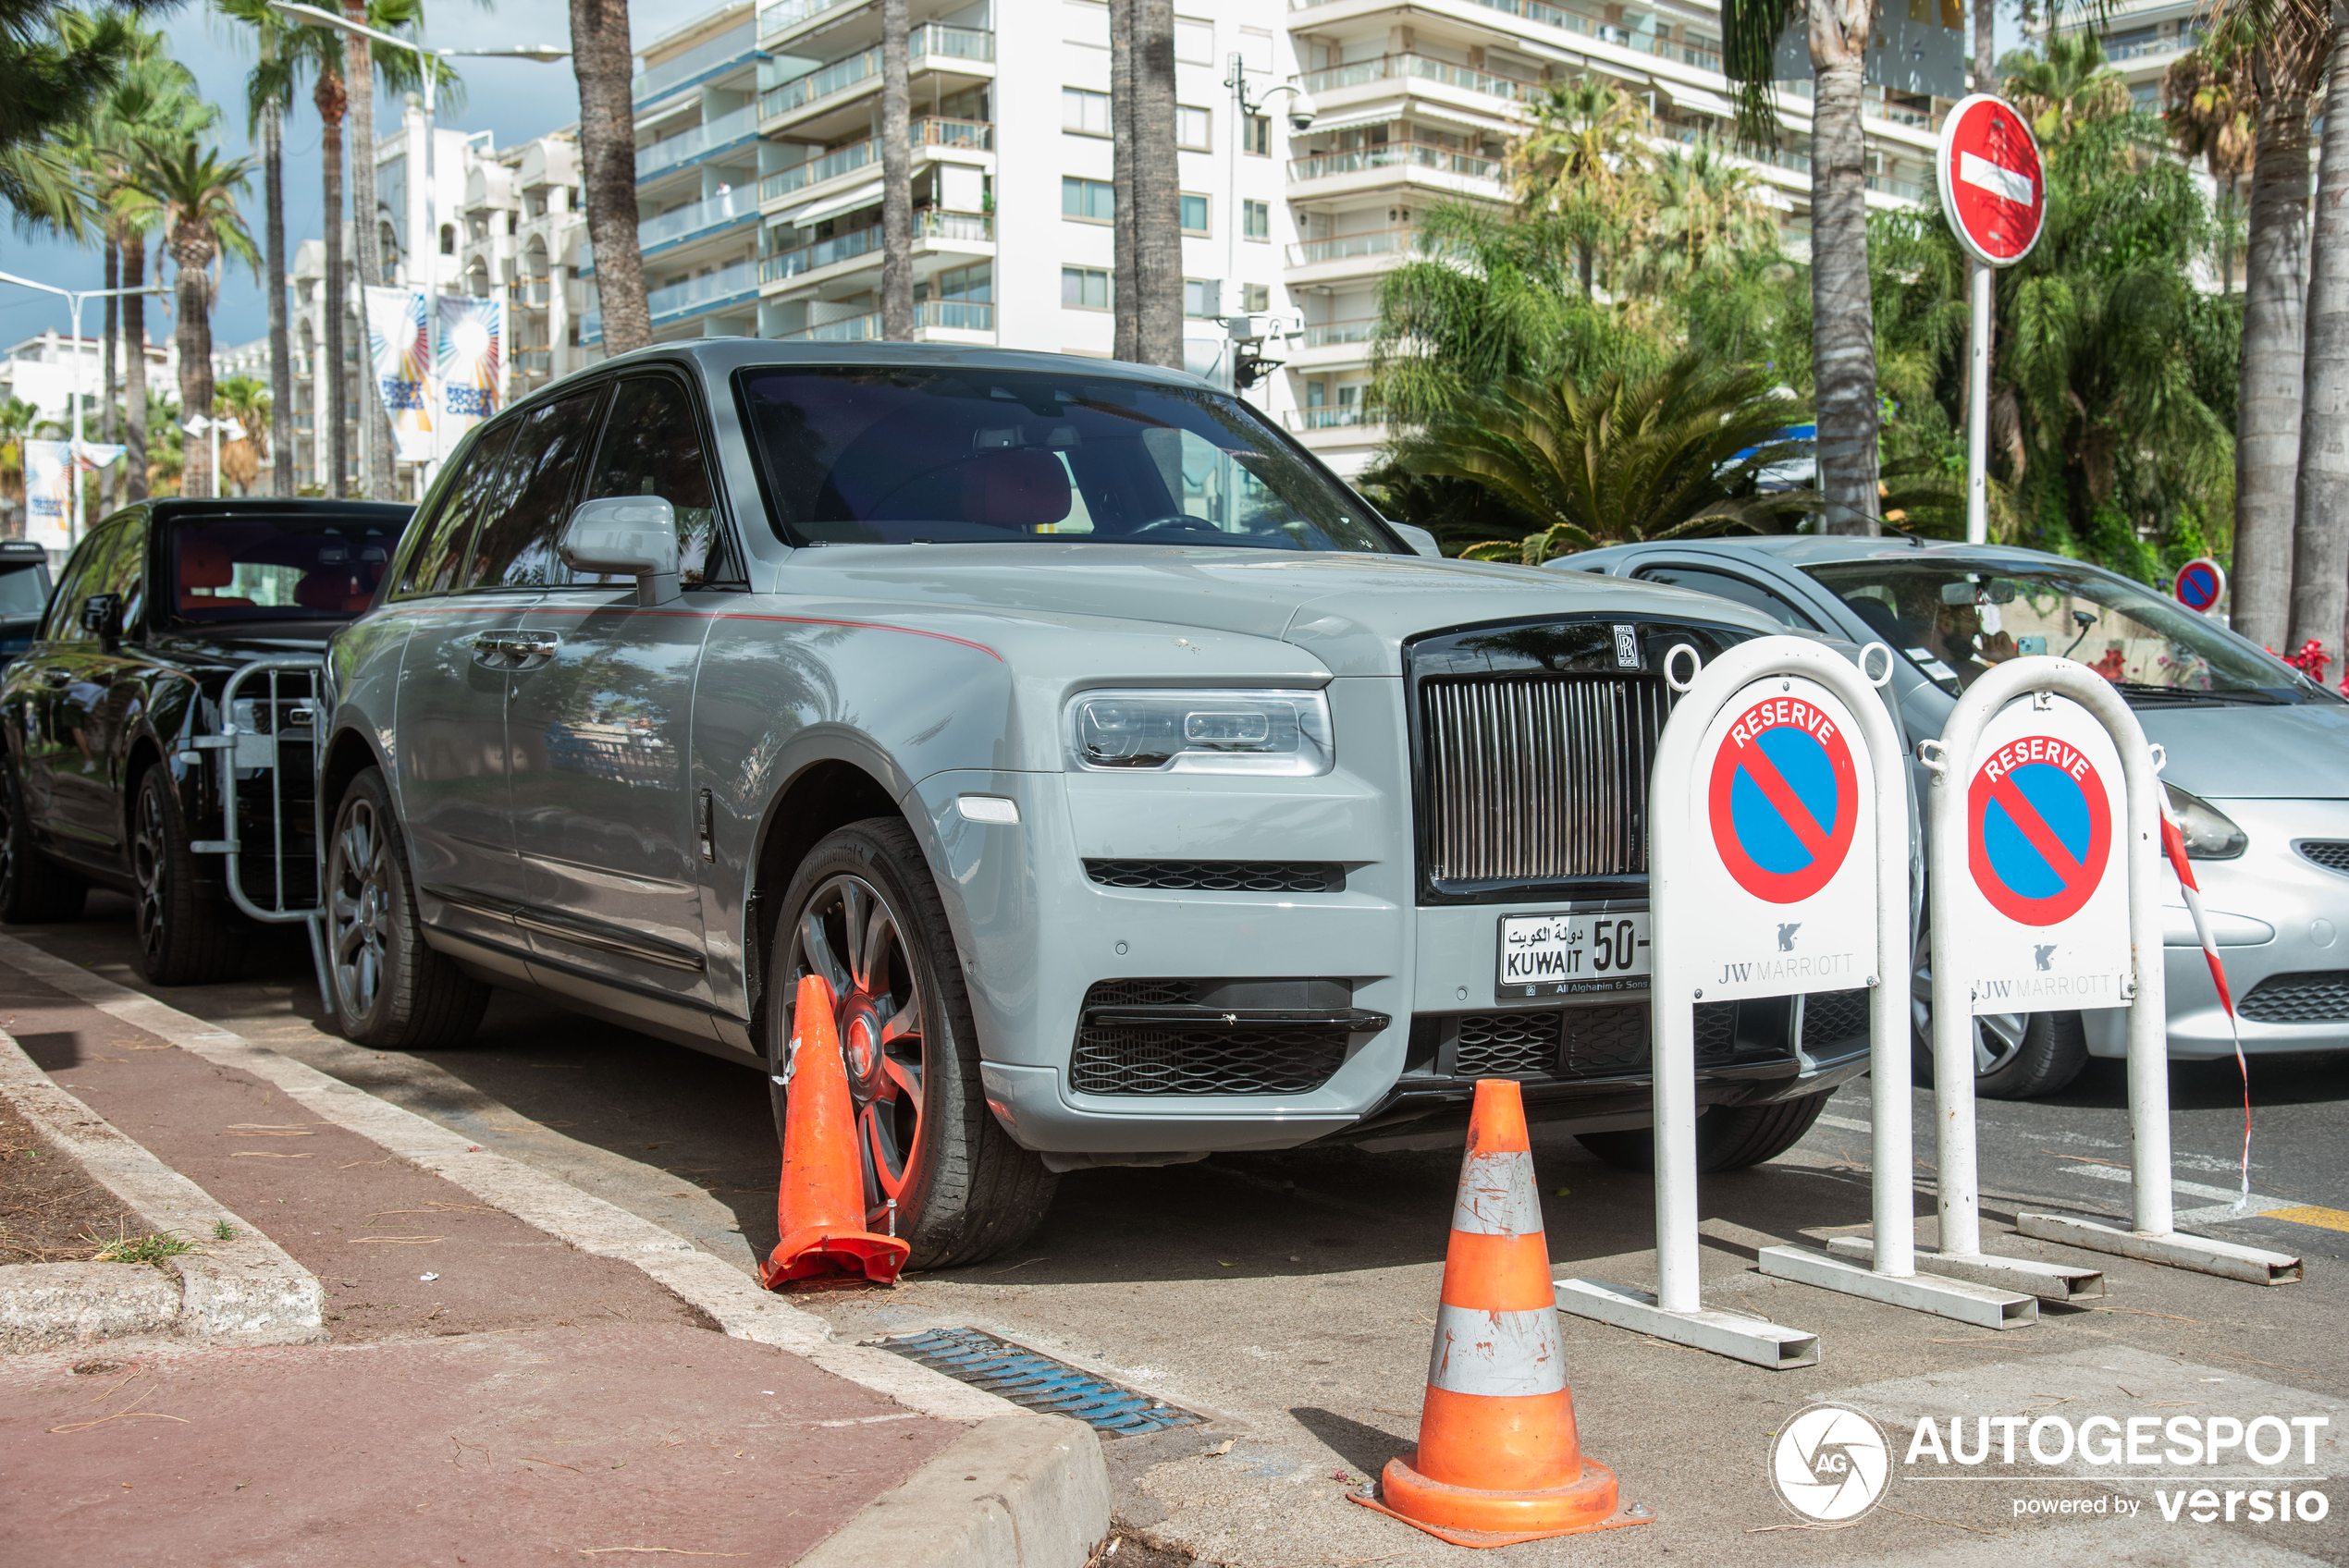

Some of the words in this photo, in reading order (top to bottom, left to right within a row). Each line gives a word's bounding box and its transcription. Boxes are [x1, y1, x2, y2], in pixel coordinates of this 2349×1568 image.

[1731, 701, 1835, 749] RESERVE
[1985, 740, 2090, 784] RESERVE
[1508, 925, 1551, 949] الكويت
[1554, 924, 1583, 945] دولة
[1507, 949, 1582, 976] KUWAIT
[1718, 962, 1753, 985] JW
[1757, 953, 1853, 981] MARRIOTT
[1616, 981, 1624, 989] &
[1626, 980, 1648, 989] Sons
[1981, 980, 2011, 999] JW
[2016, 974, 2110, 998] MARRIOTT
